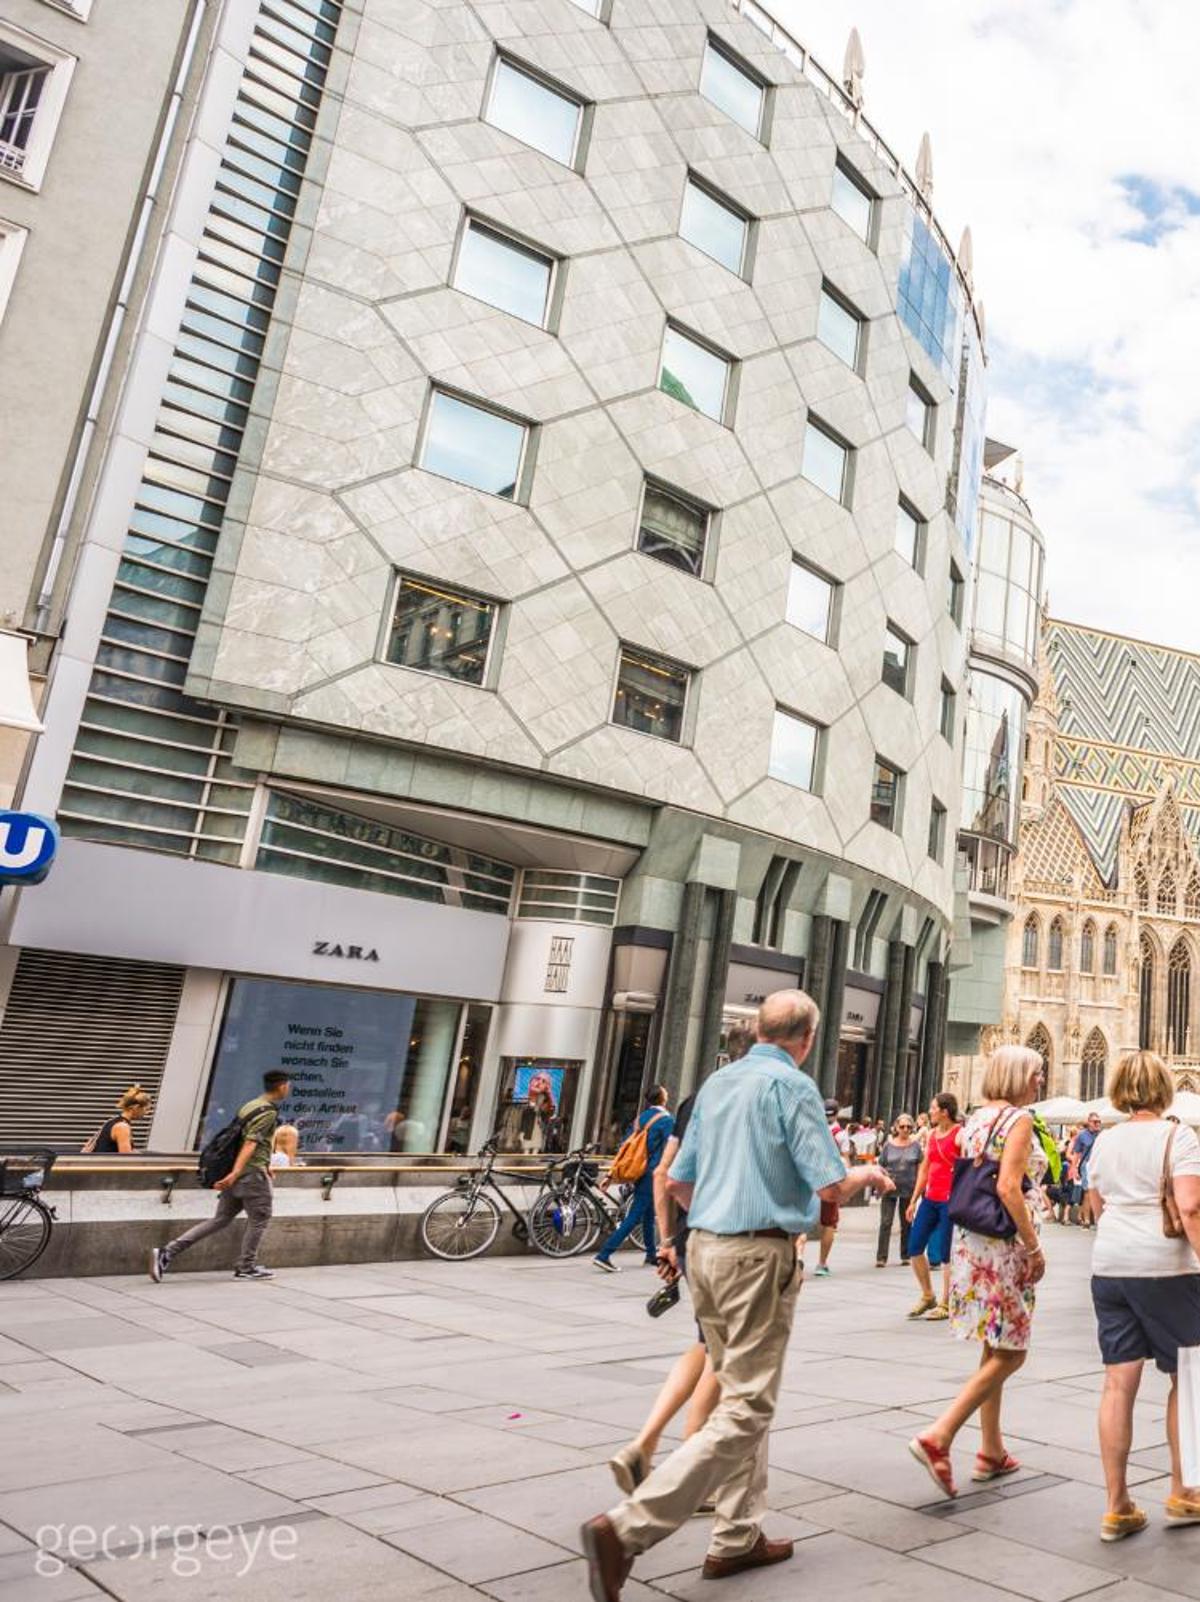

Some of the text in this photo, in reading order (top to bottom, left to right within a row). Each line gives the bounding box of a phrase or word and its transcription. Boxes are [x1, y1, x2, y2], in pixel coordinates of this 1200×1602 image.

[0, 821, 47, 869] U
[312, 941, 381, 963] ZARA
[287, 1023, 344, 1038] Wenn Sie
[283, 1040, 355, 1054] nicht finden
[280, 1056, 350, 1068] wonach Sie
